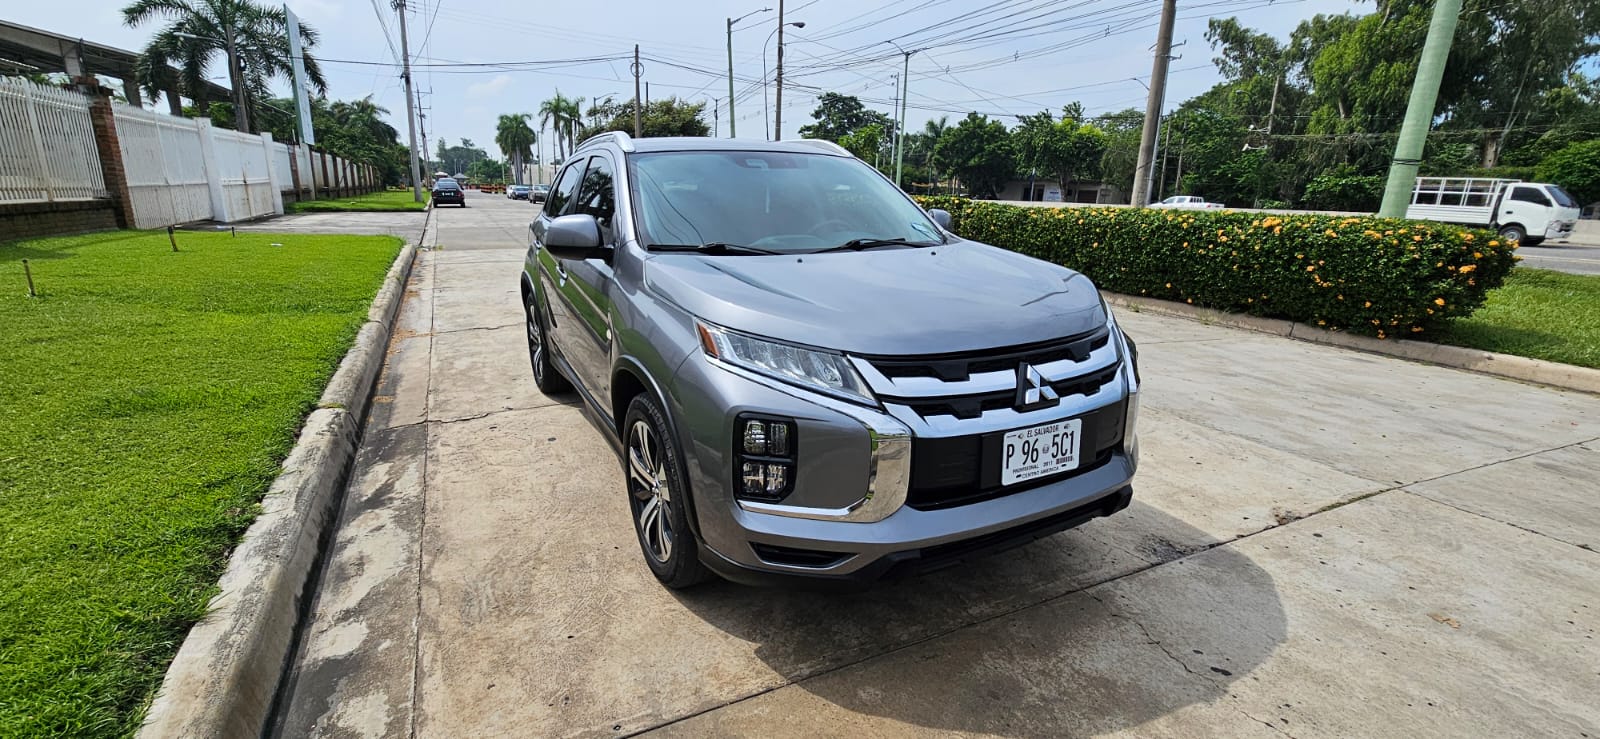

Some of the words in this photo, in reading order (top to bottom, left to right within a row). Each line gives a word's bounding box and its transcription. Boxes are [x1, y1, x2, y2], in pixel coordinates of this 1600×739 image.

[1034, 425, 1059, 436] SALVADOR
[1006, 444, 1014, 469] P
[1022, 438, 1039, 465] 96
[1052, 430, 1074, 458] 5C1
